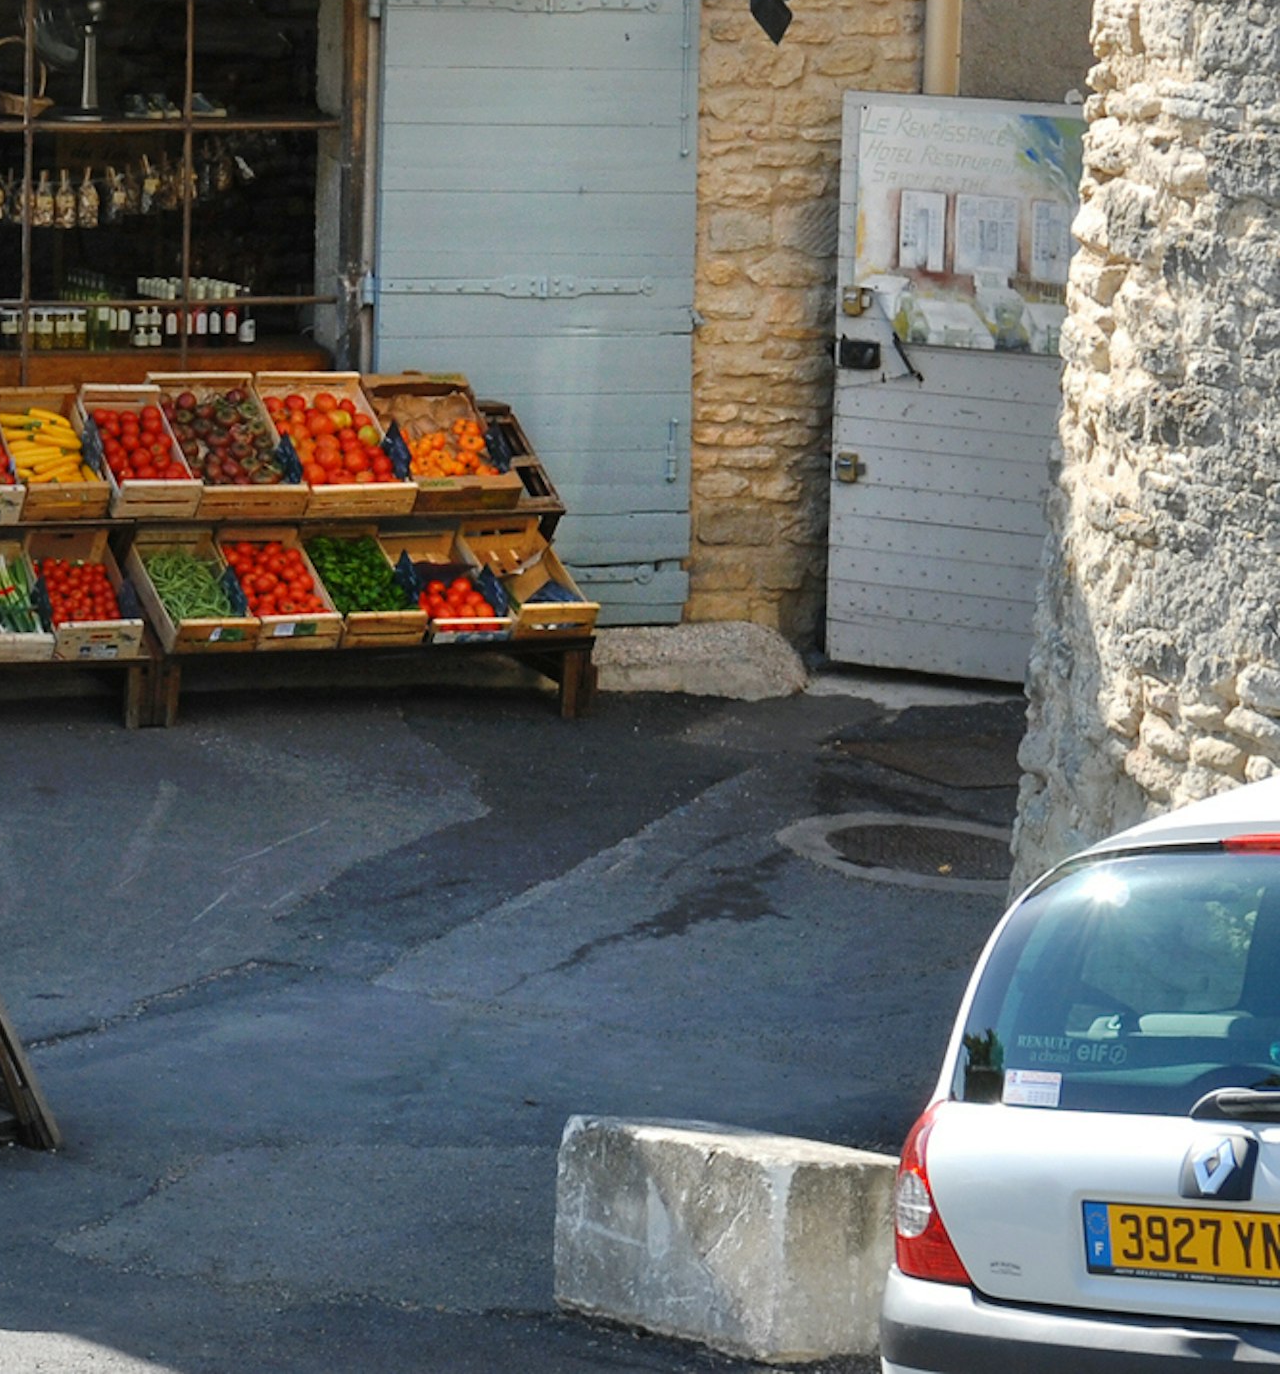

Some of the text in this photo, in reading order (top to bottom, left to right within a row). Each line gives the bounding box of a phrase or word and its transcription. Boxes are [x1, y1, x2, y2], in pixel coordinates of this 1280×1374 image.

[1076, 1044, 1109, 1062] elf
[1093, 1241, 1105, 1257] F
[1119, 1213, 1222, 1268] 3927
